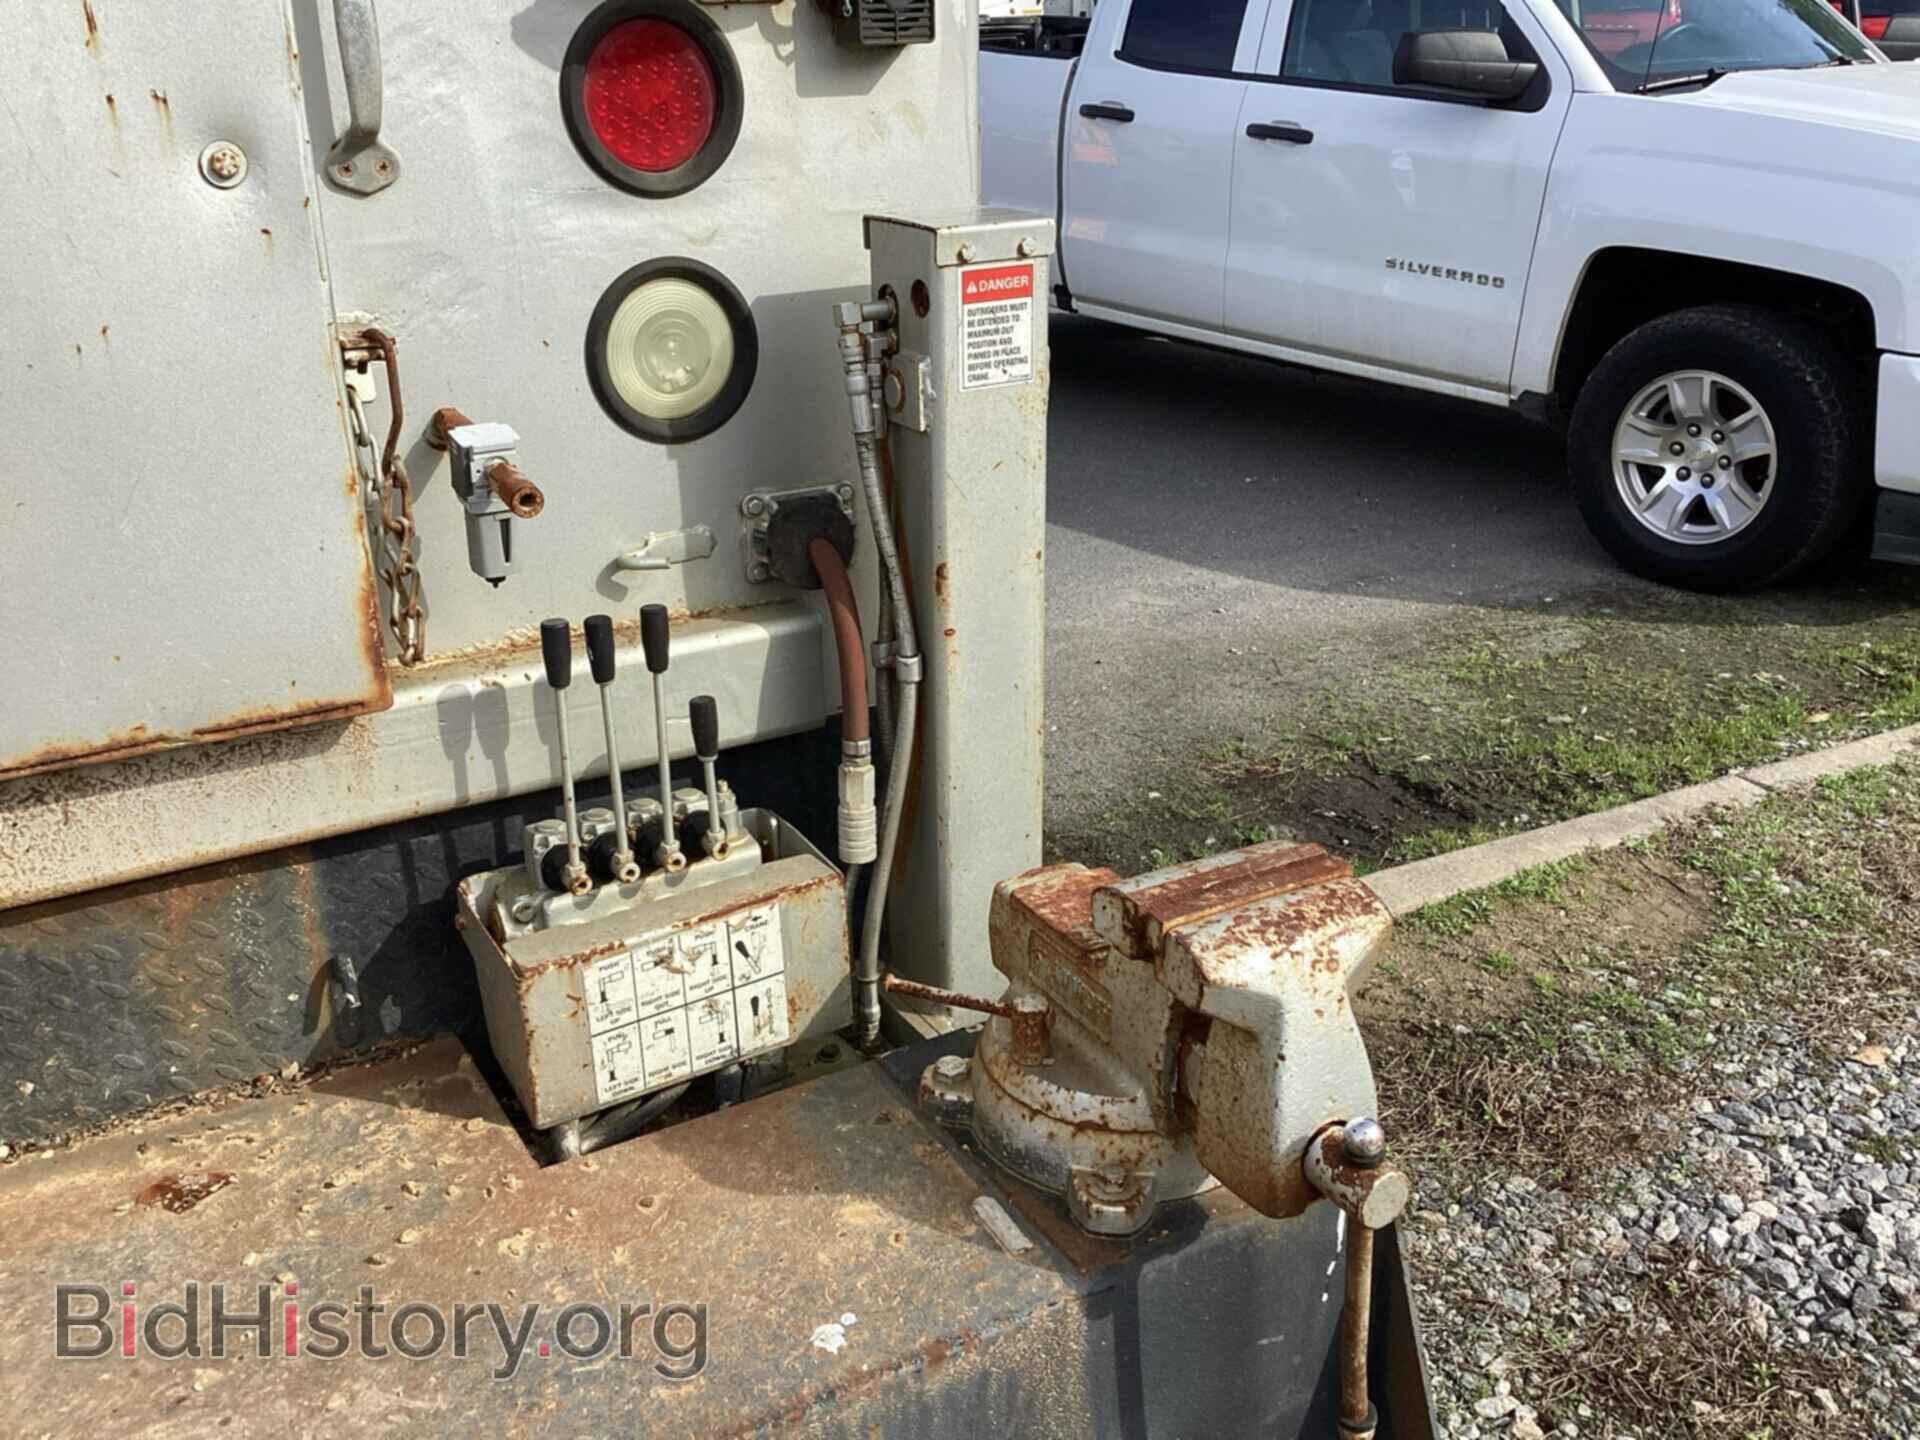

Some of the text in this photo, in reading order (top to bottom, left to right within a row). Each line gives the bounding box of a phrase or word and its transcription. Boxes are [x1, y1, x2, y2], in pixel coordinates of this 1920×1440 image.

[1385, 257, 1505, 289] SILVERADO
[978, 276, 1029, 292] DANGER
[967, 302, 1028, 317] OUTRIGGERS MUST
[967, 314, 1020, 328] BE EXTENDED TO
[967, 325, 1014, 339] MAXIMUM OUT
[967, 337, 1012, 350] POSITION AND
[967, 346, 1021, 361] PINNED IN PLACE
[967, 356, 1028, 372] BEFORE OPERATING
[967, 372, 989, 383] CRANE
